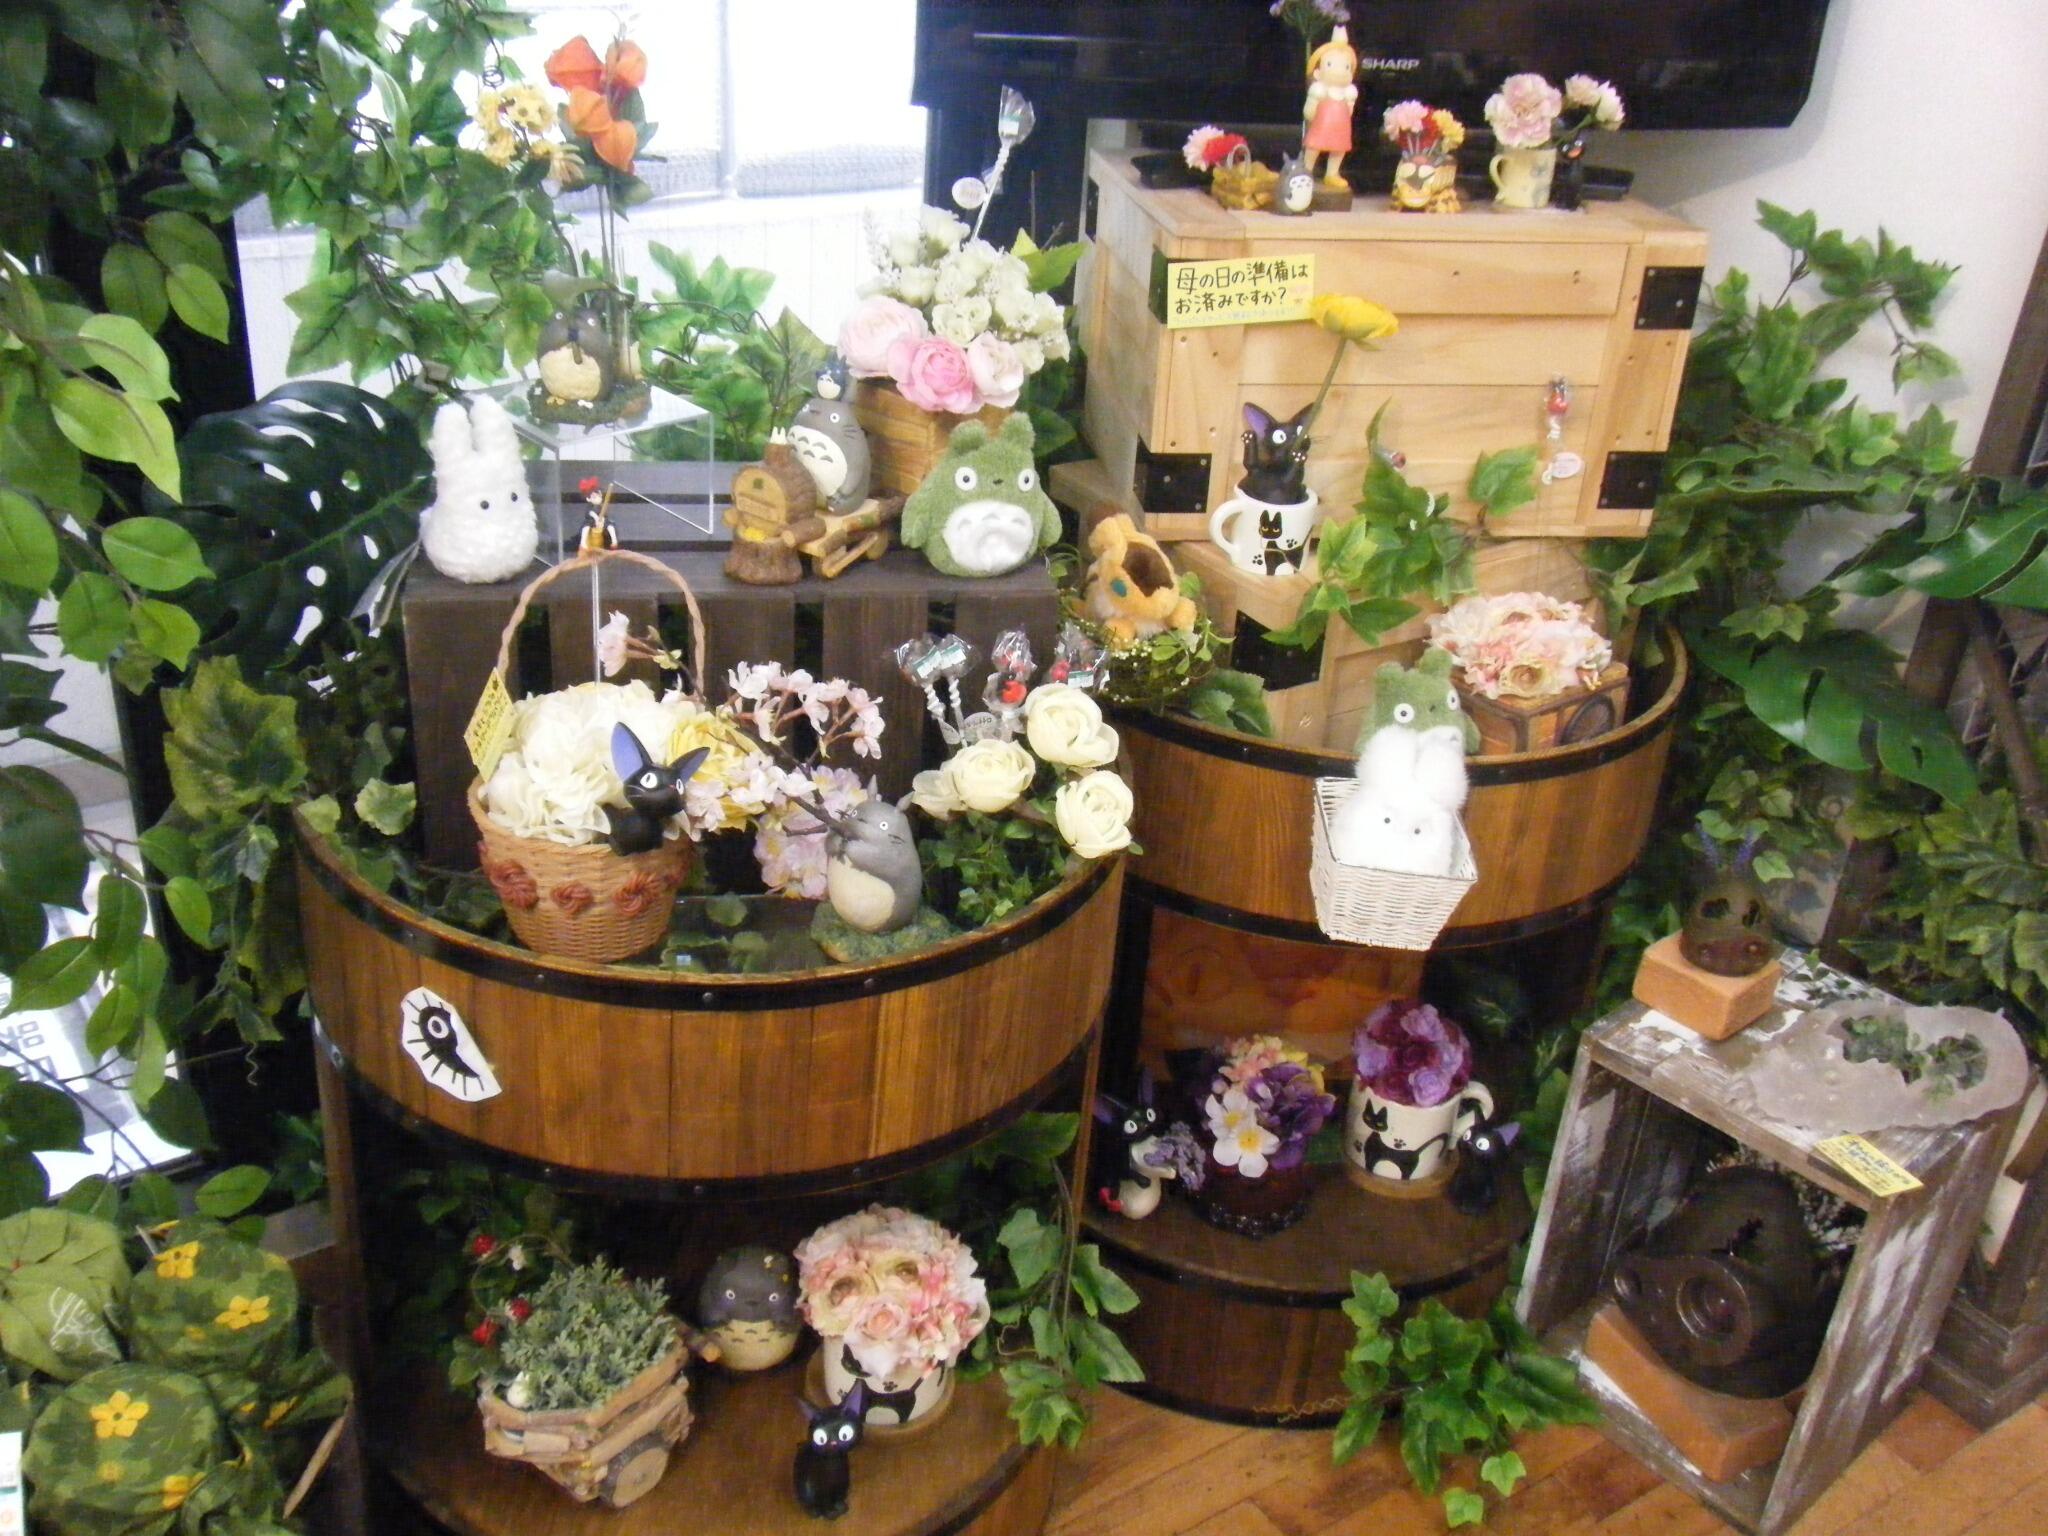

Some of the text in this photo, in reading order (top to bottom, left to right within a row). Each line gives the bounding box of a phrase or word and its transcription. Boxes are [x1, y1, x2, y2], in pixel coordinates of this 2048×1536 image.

[1361, 58, 1420, 70] SHARP
[1176, 260, 1308, 294] 母の日の準備は
